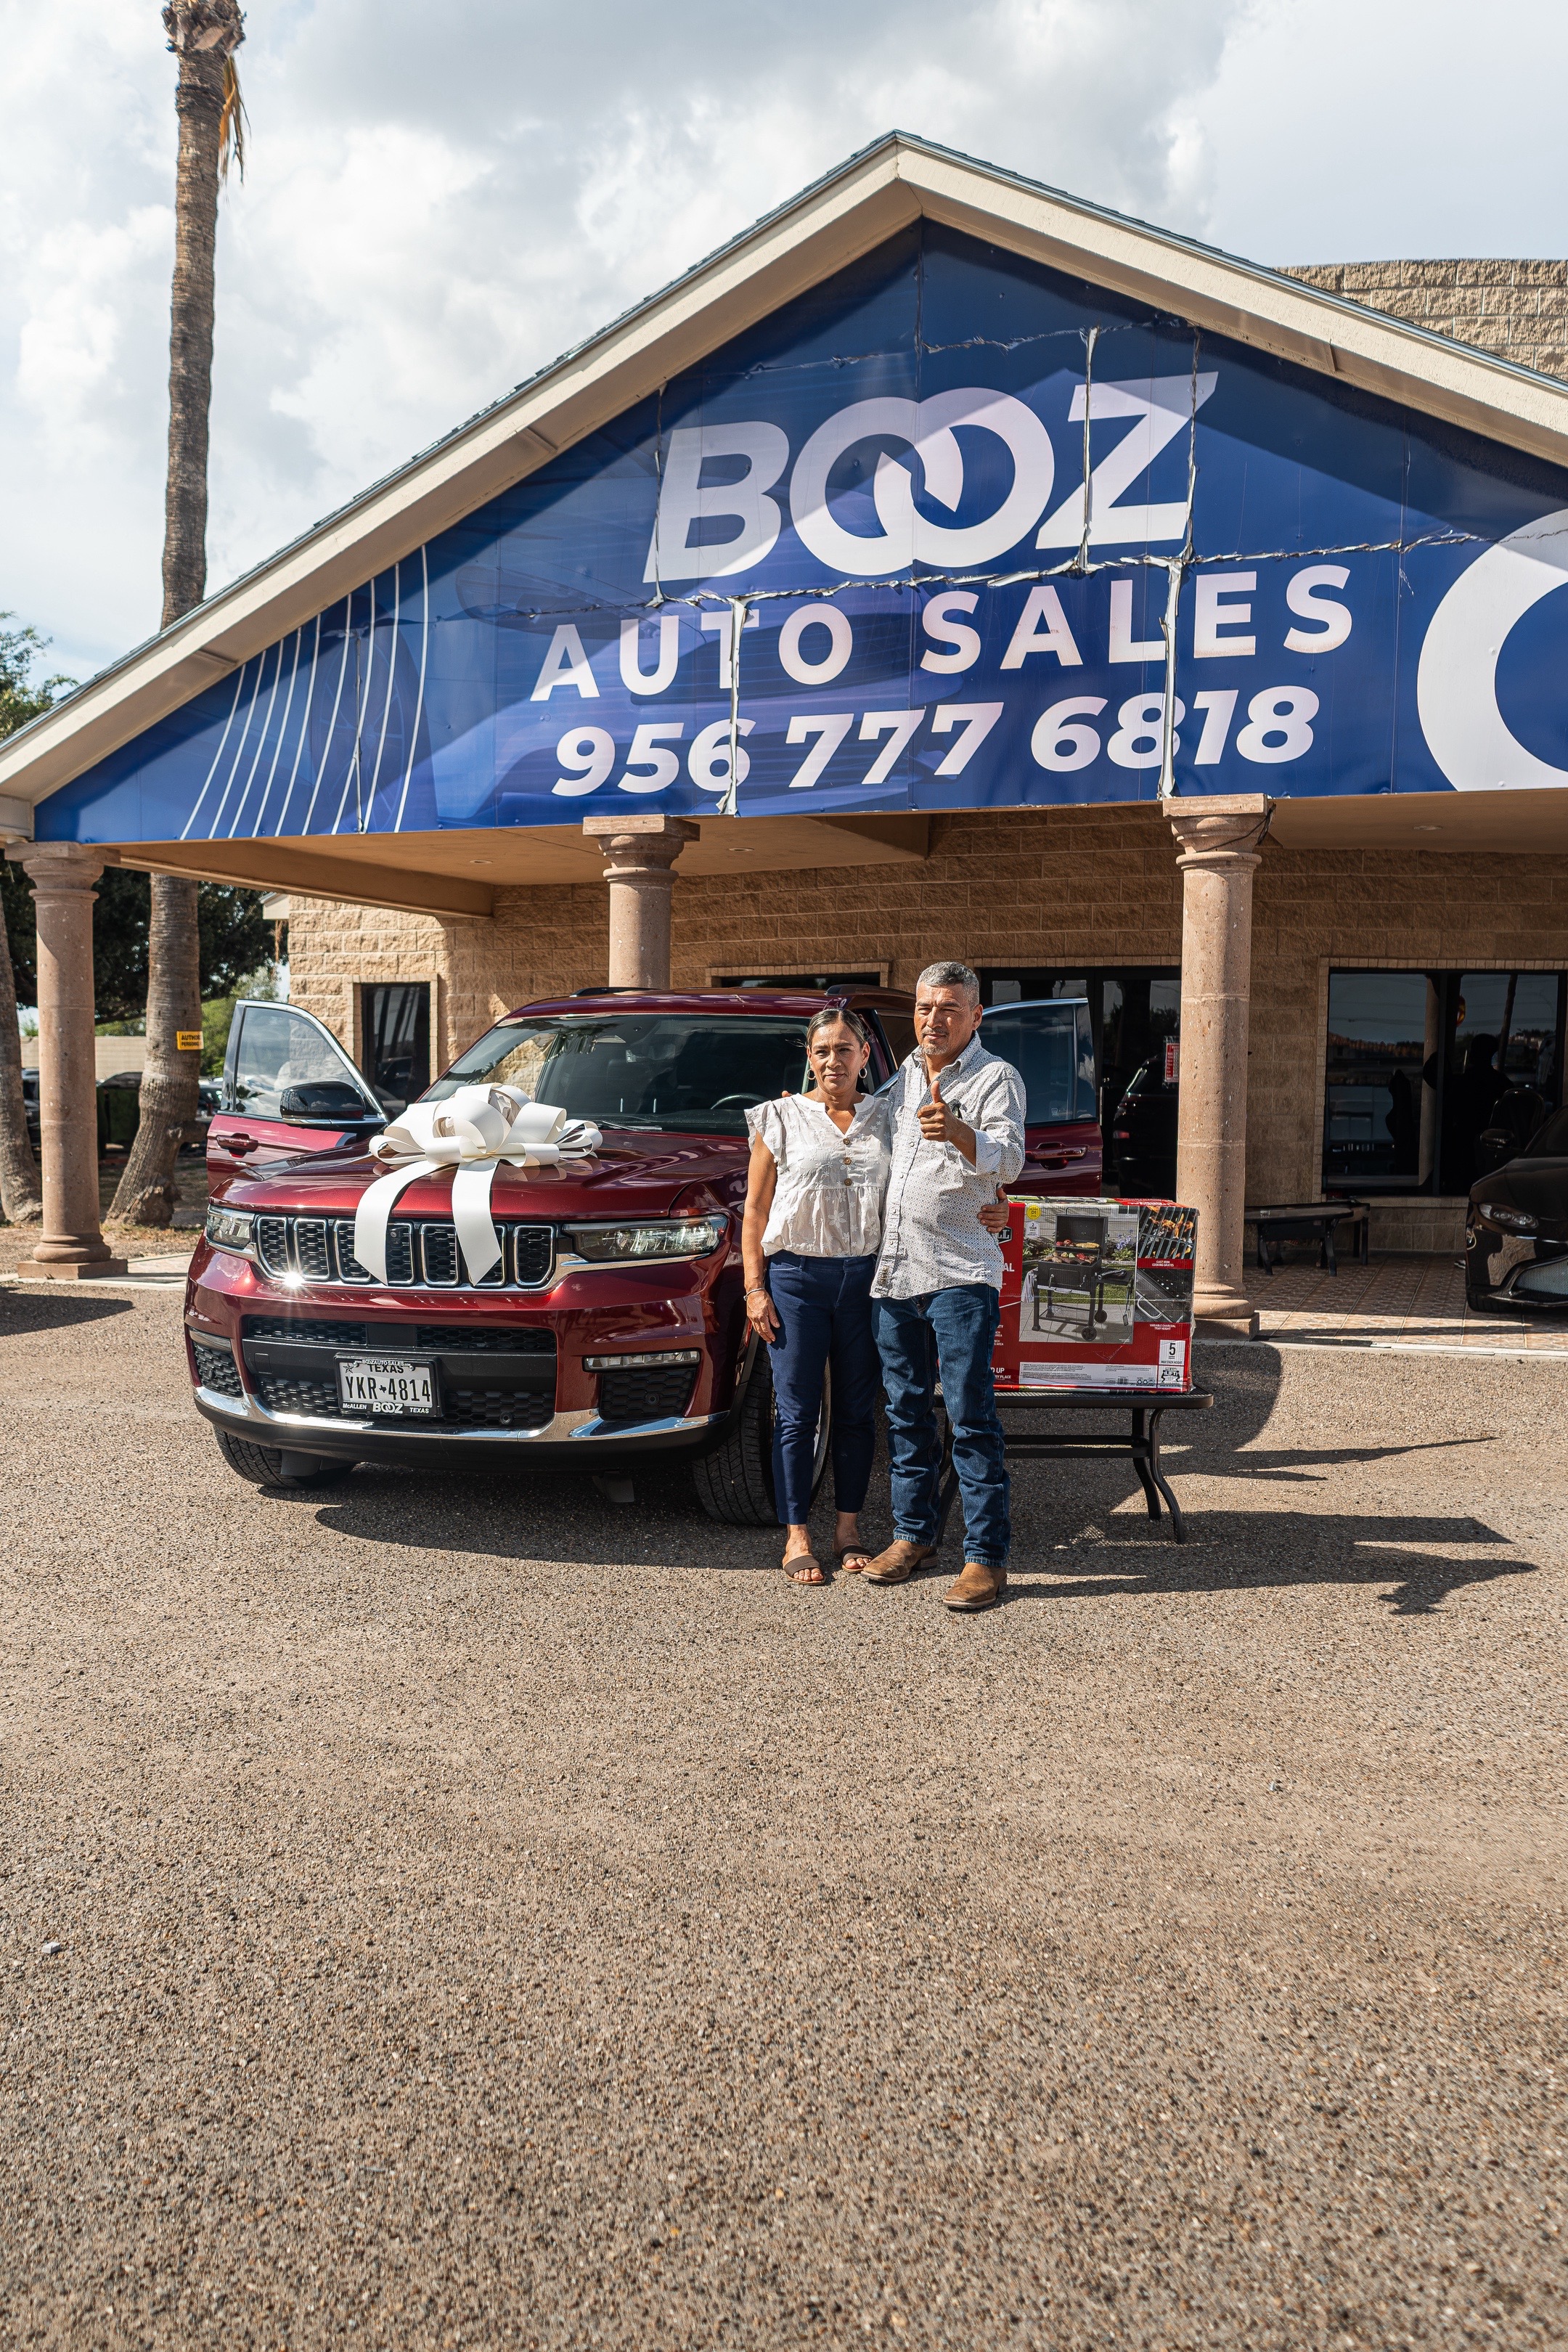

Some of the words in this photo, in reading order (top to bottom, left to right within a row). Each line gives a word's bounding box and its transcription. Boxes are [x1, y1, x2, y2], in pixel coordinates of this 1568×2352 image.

[642, 371, 1218, 584] BOOZ
[530, 603, 853, 702] AUTO
[920, 565, 1353, 675] SALES
[552, 718, 751, 798] 956
[785, 701, 1004, 788] 777
[1031, 685, 1320, 773] 6818
[1169, 1343, 1176, 1355] 5
[368, 1364, 404, 1373] TEXAS
[346, 1376, 377, 1400] YKR
[388, 1378, 430, 1402] 4814
[372, 1402, 404, 1414] BOOZ
